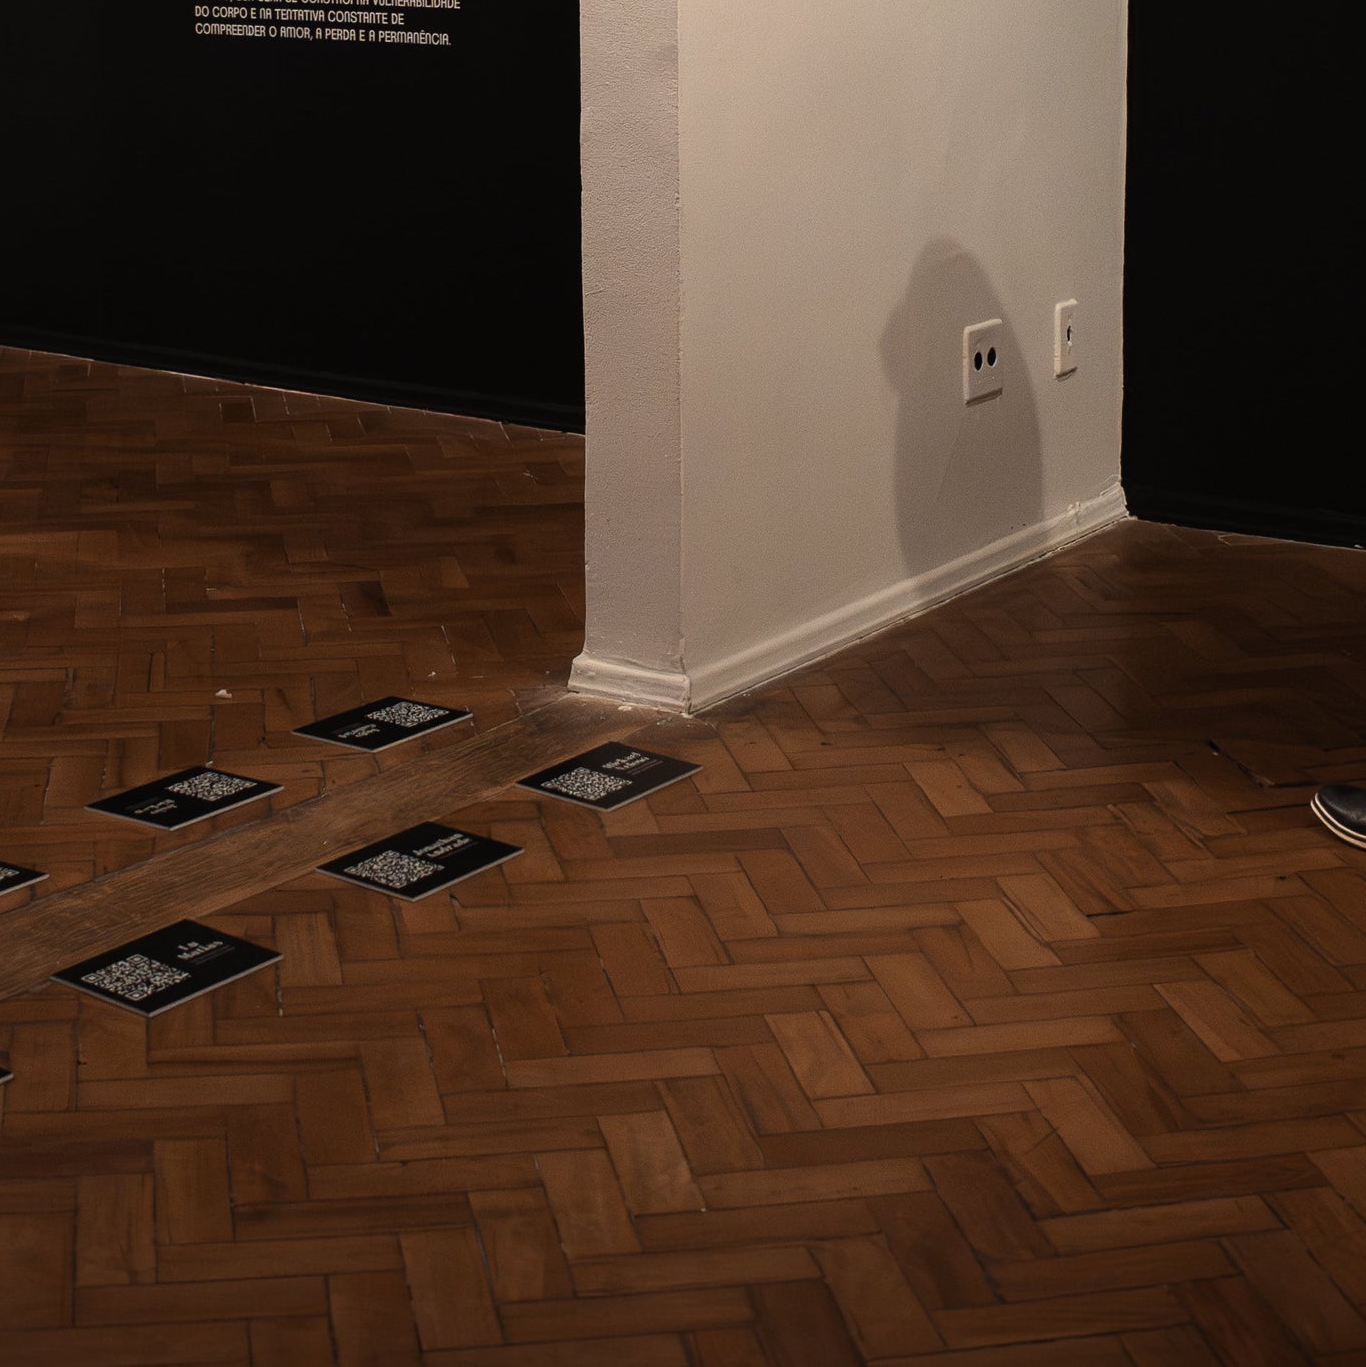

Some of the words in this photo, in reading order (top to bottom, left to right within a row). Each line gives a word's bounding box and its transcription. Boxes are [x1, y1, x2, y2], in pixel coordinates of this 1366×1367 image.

[195, 5, 209, 17] DO
[212, 5, 247, 18] CORPO
[260, 7, 272, 19] NA
[274, 8, 325, 22] TENTATIVA
[328, 10, 388, 24] CONSTANTE
[391, 13, 404, 25] DE
[195, 22, 266, 37] COMPREENDER
[325, 27, 356, 41] PERDA
